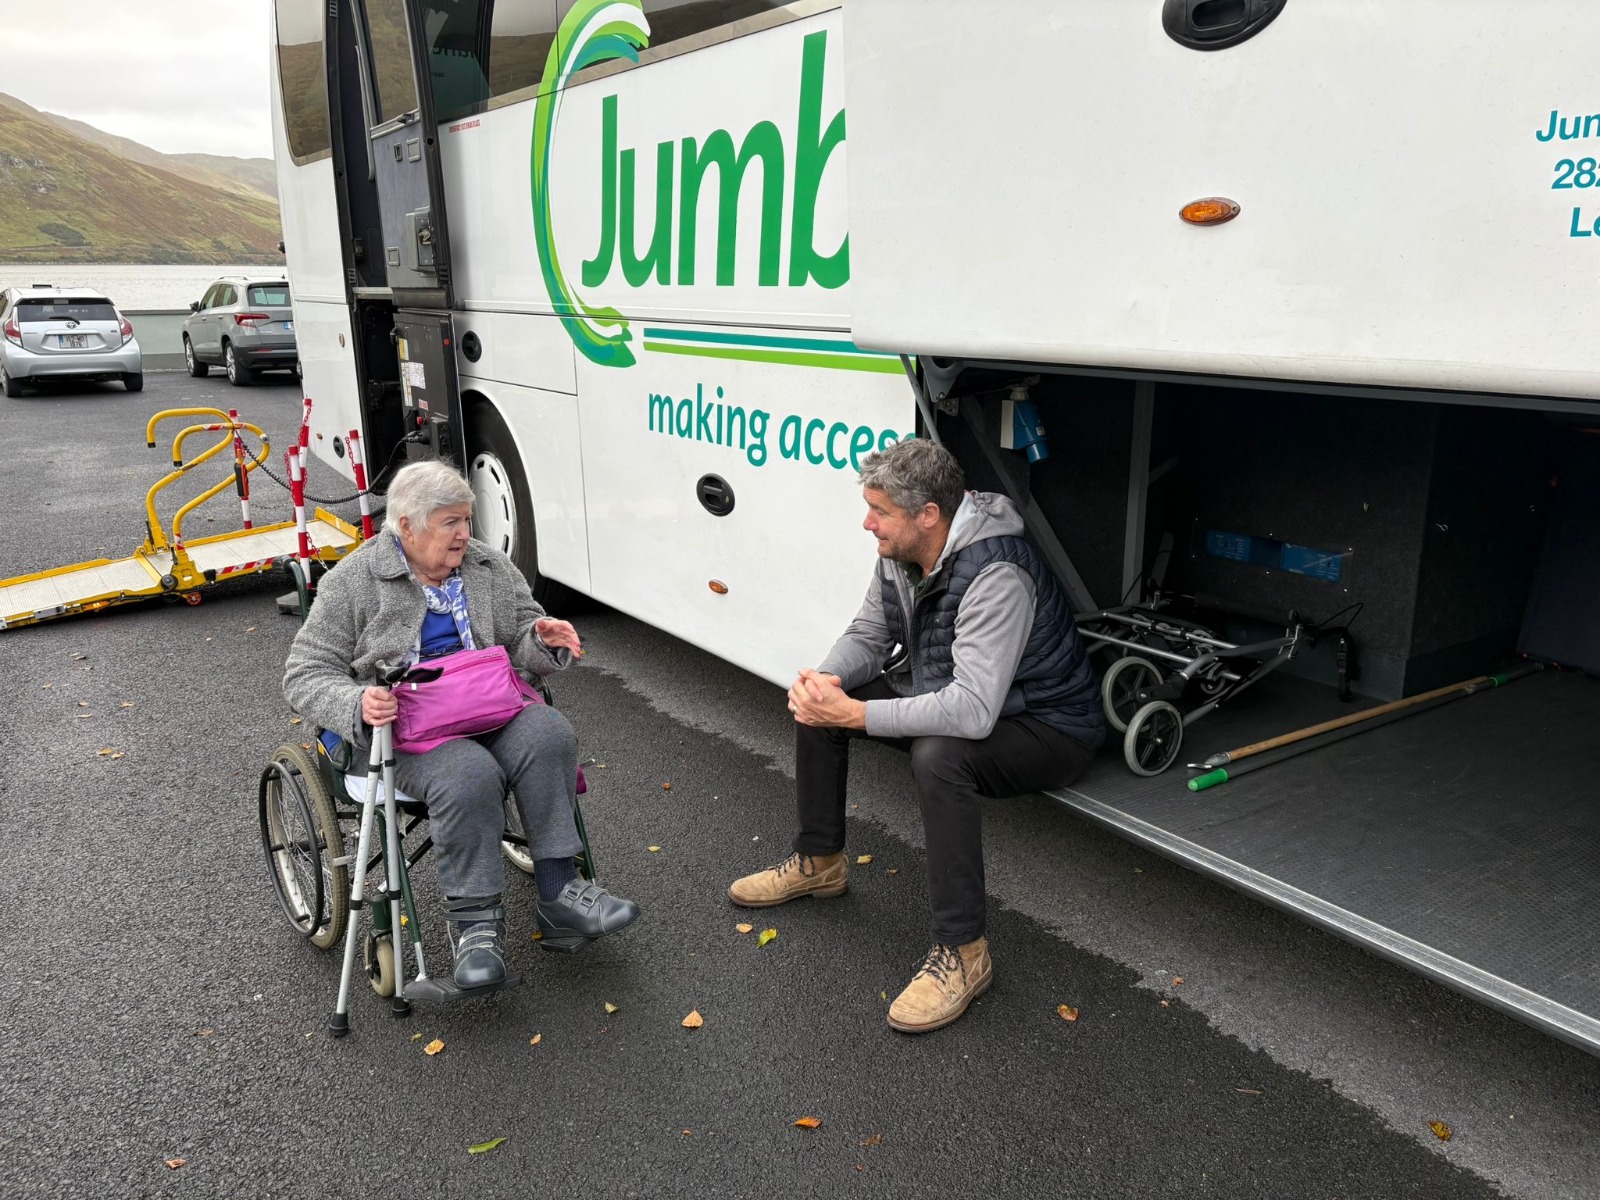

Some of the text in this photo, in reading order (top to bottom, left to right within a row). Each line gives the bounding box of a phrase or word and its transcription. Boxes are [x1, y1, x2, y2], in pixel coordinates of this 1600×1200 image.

[1551, 157, 1600, 190] 28
[649, 383, 915, 474] making acce
